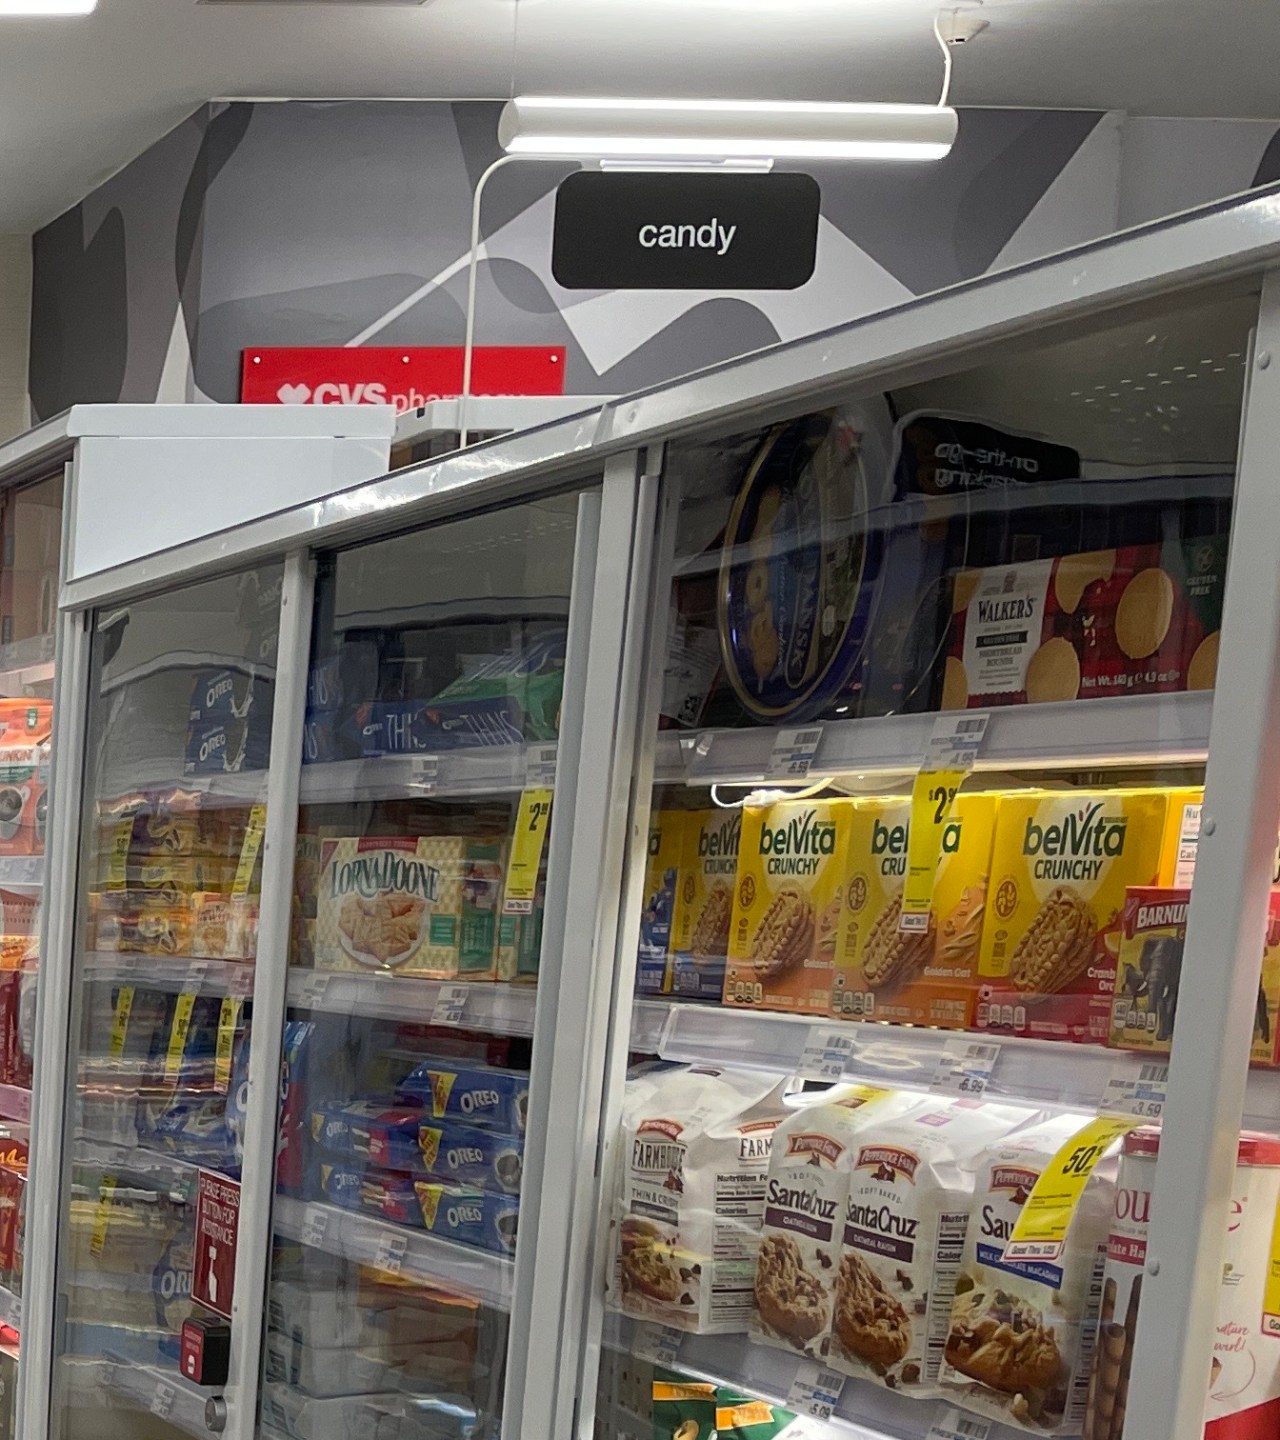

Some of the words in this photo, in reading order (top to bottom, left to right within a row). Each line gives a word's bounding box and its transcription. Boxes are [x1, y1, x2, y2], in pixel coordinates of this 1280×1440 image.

[638, 218, 737, 256] candy
[312, 382, 387, 404] CVS
[1186, 574, 1218, 588] GLUTEN
[1190, 584, 1212, 597] FREE
[978, 597, 1036, 625] WALKER'S
[206, 678, 233, 709] OREO
[199, 730, 227, 762] OREO
[759, 809, 837, 855] belVita
[1022, 801, 1129, 857] belVita
[330, 856, 384, 900] LORNA
[380, 850, 439, 903] DOONE
[767, 857, 821, 877] CRUNCHY
[1033, 859, 1105, 881] CRUNCHY
[803, 958, 828, 970] Golden
[923, 965, 951, 978] Golden
[953, 966, 971, 979] Oat
[958, 1077, 984, 1095] $6.99
[460, 1089, 500, 1114] OREO
[446, 1147, 484, 1171] OREO
[631, 1139, 688, 1178] FARMHOUSE
[897, 1152, 917, 1171] FARM
[716, 1173, 757, 1184] Nutrition
[219, 1183, 241, 1208] PRESS
[220, 1207, 236, 1226] FOR
[446, 1206, 483, 1229] OREO
[715, 1206, 748, 1216] Calories
[808, 1403, 832, 1420] $5.09
